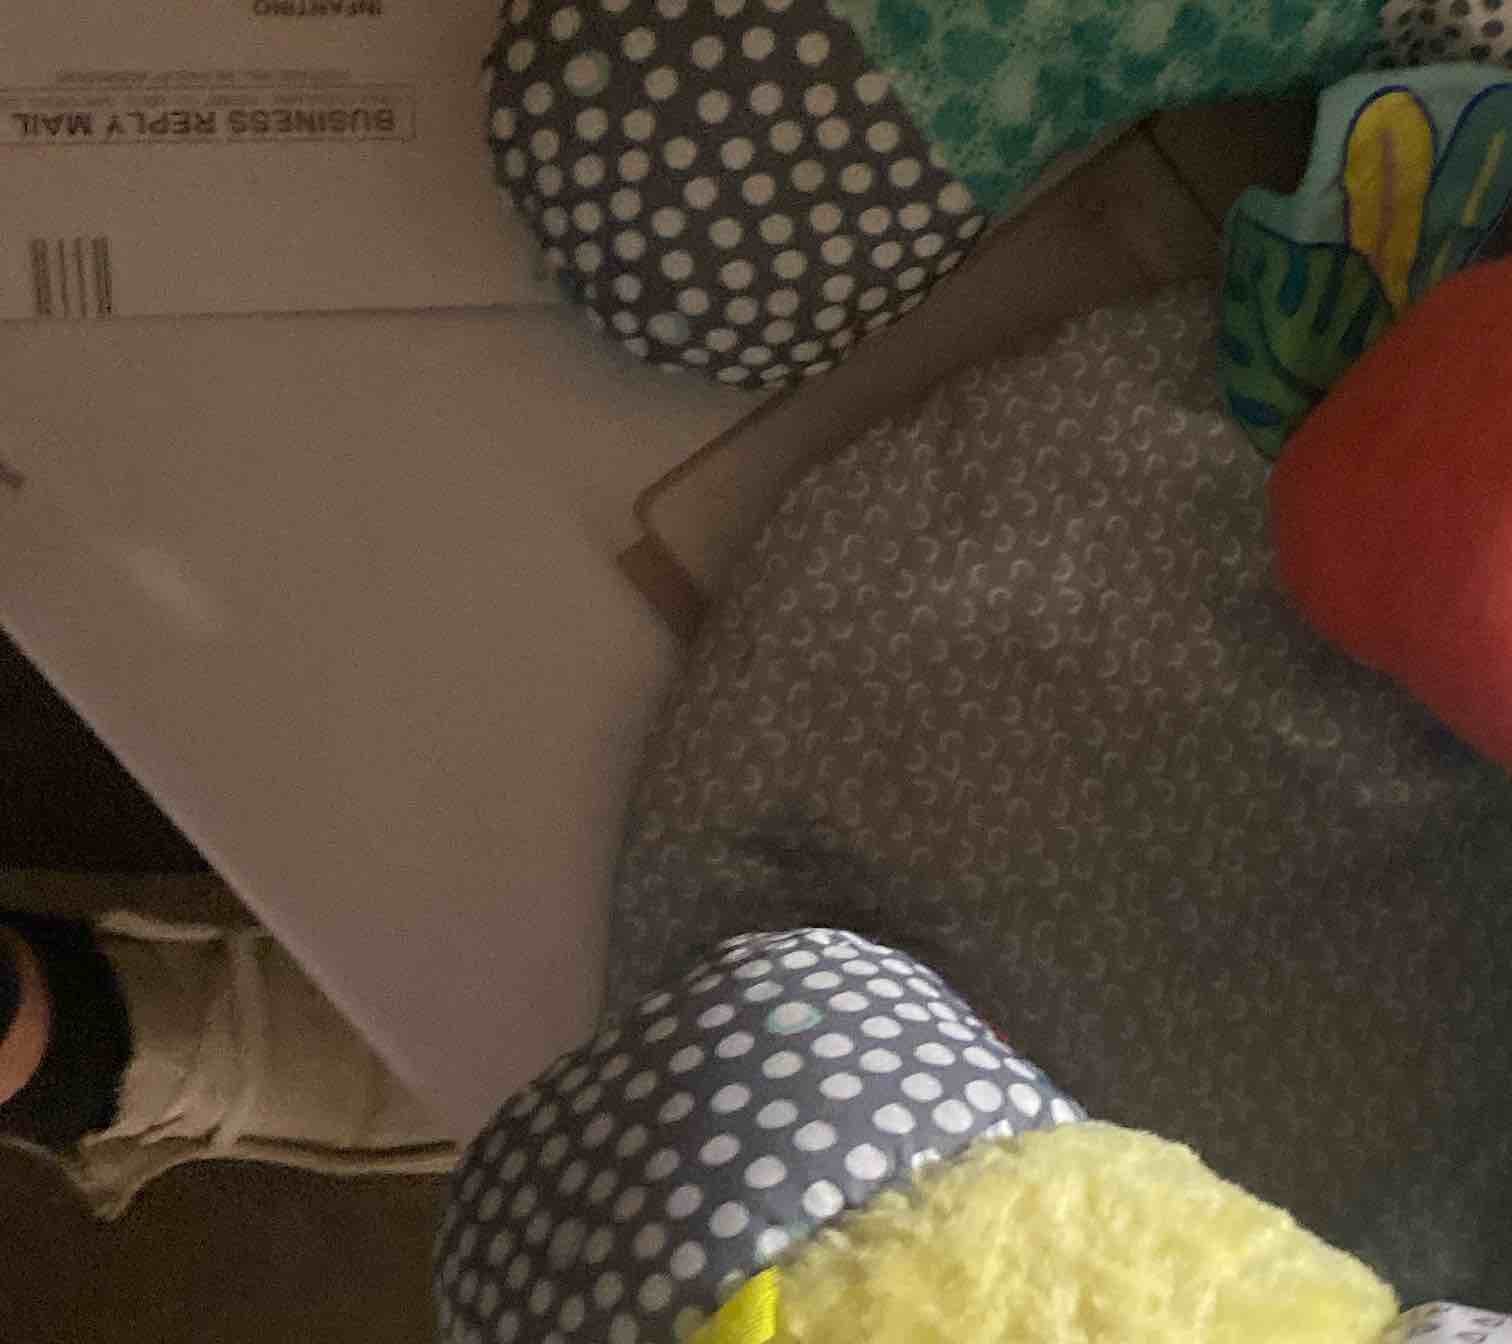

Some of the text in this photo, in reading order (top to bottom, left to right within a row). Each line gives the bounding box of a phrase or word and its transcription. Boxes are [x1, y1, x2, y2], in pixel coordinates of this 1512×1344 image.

[11, 108, 395, 137] BUSINESS REPLY MAIL
